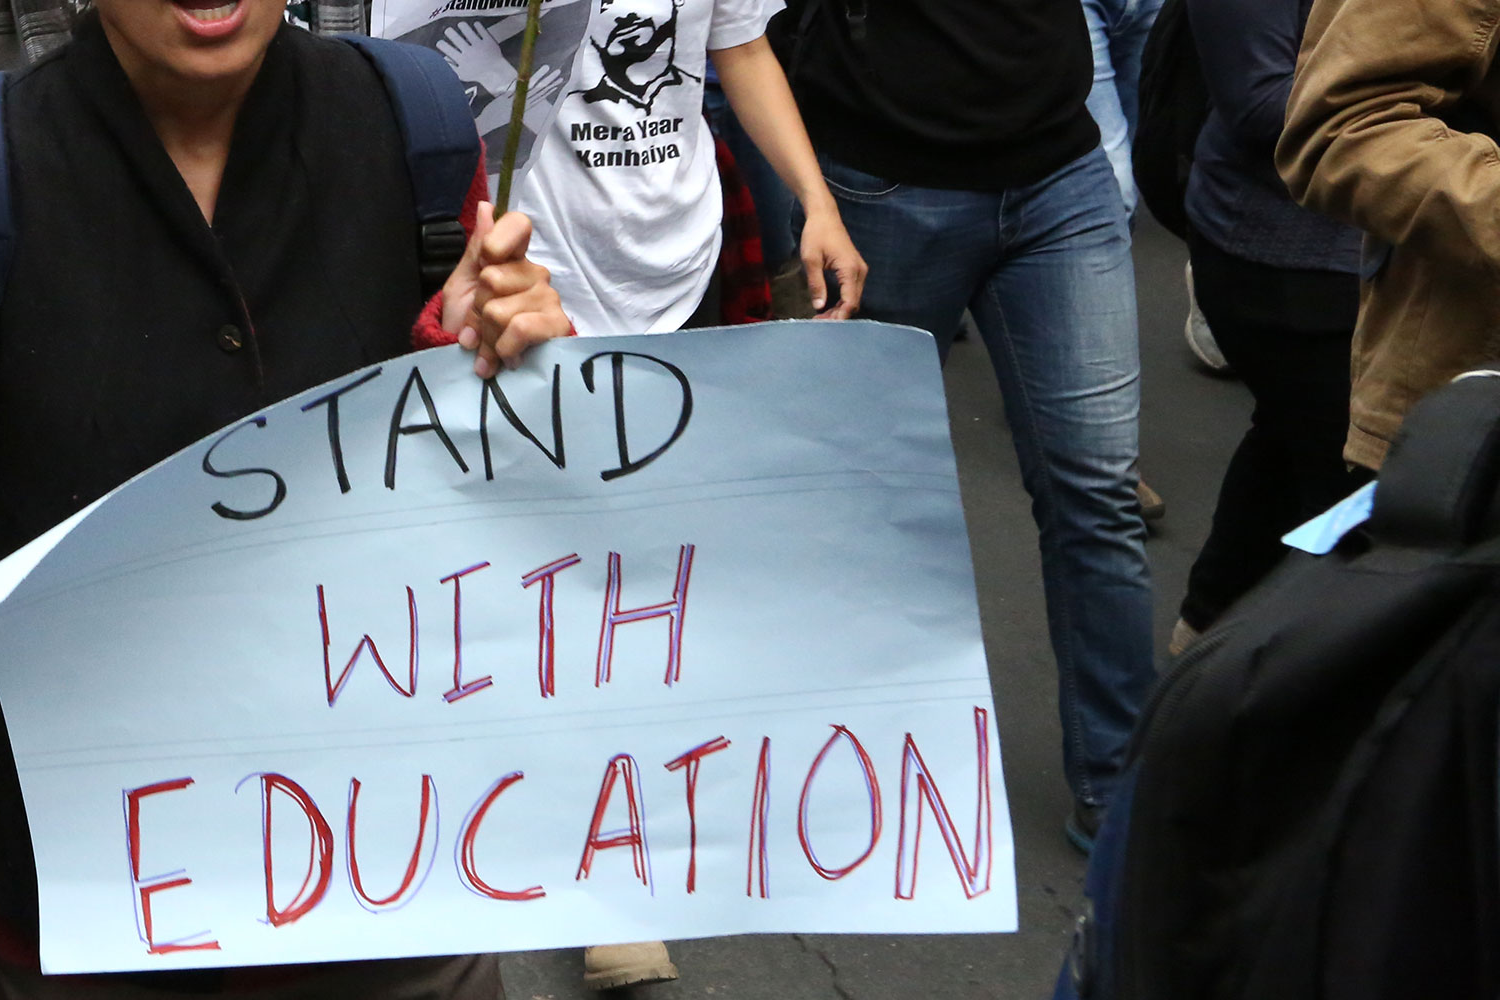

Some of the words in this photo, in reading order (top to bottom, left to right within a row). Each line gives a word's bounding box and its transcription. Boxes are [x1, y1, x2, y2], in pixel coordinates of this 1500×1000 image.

[571, 121, 635, 142] Mera
[637, 115, 683, 138] Yaar
[574, 144, 680, 169] Kanhaiya
[203, 350, 694, 520] STAND
[316, 543, 696, 707] WITH
[120, 706, 993, 956] EDUCATION
